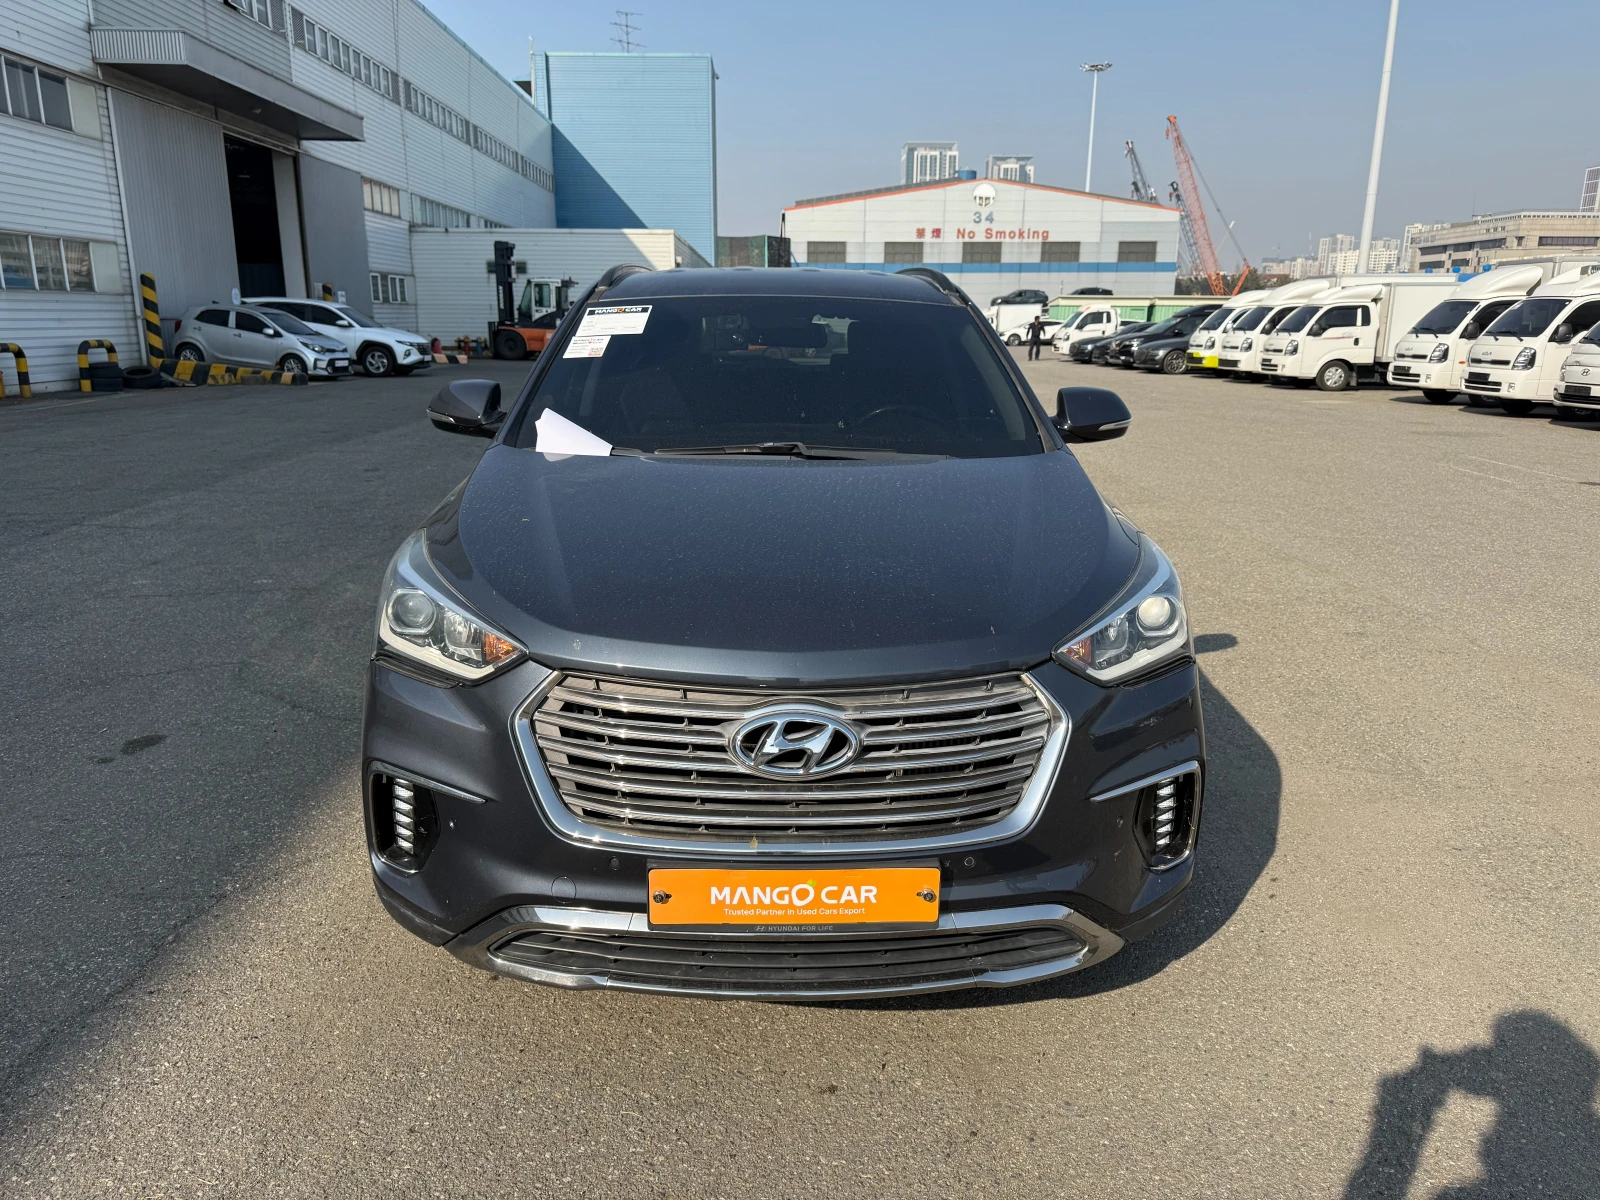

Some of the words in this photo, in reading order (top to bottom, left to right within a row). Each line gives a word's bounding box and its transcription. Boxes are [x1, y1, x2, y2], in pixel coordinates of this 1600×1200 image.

[973, 211, 994, 224] 34
[956, 228, 976, 239] No
[984, 227, 1050, 241] Smoking
[710, 883, 815, 907] MANGO
[820, 885, 878, 904] CAR
[723, 908, 754, 916] Trusted
[756, 908, 785, 916] Partner
[787, 908, 795, 916] In
[839, 907, 866, 916] Export
